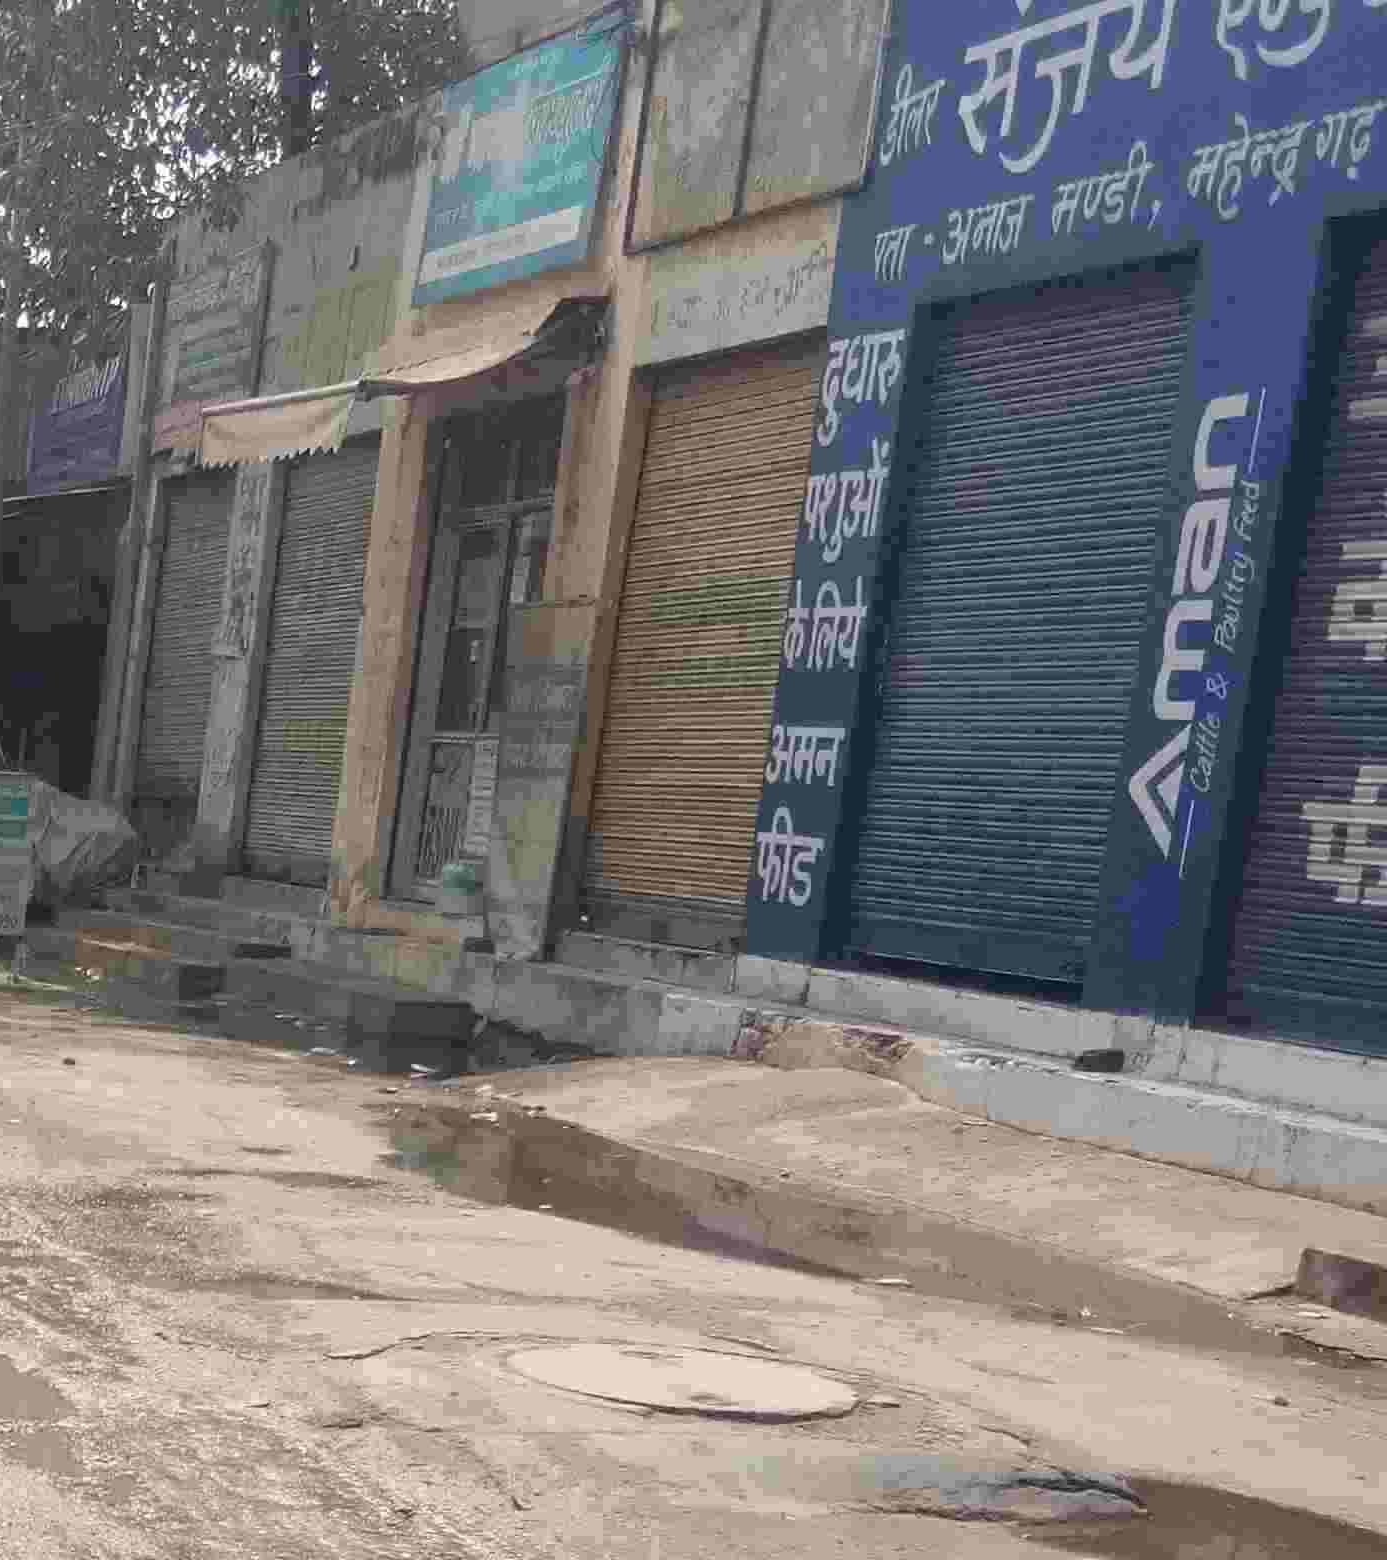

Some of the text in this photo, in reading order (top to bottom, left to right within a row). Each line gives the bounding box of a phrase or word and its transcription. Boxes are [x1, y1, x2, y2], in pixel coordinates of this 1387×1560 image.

[804, 436, 891, 563] पशुओं
[1128, 391, 1249, 859] Aman
[1190, 479, 1261, 794] Cattle & Poultry Feed
[765, 725, 846, 787] अमन
[755, 806, 825, 907] फीड
